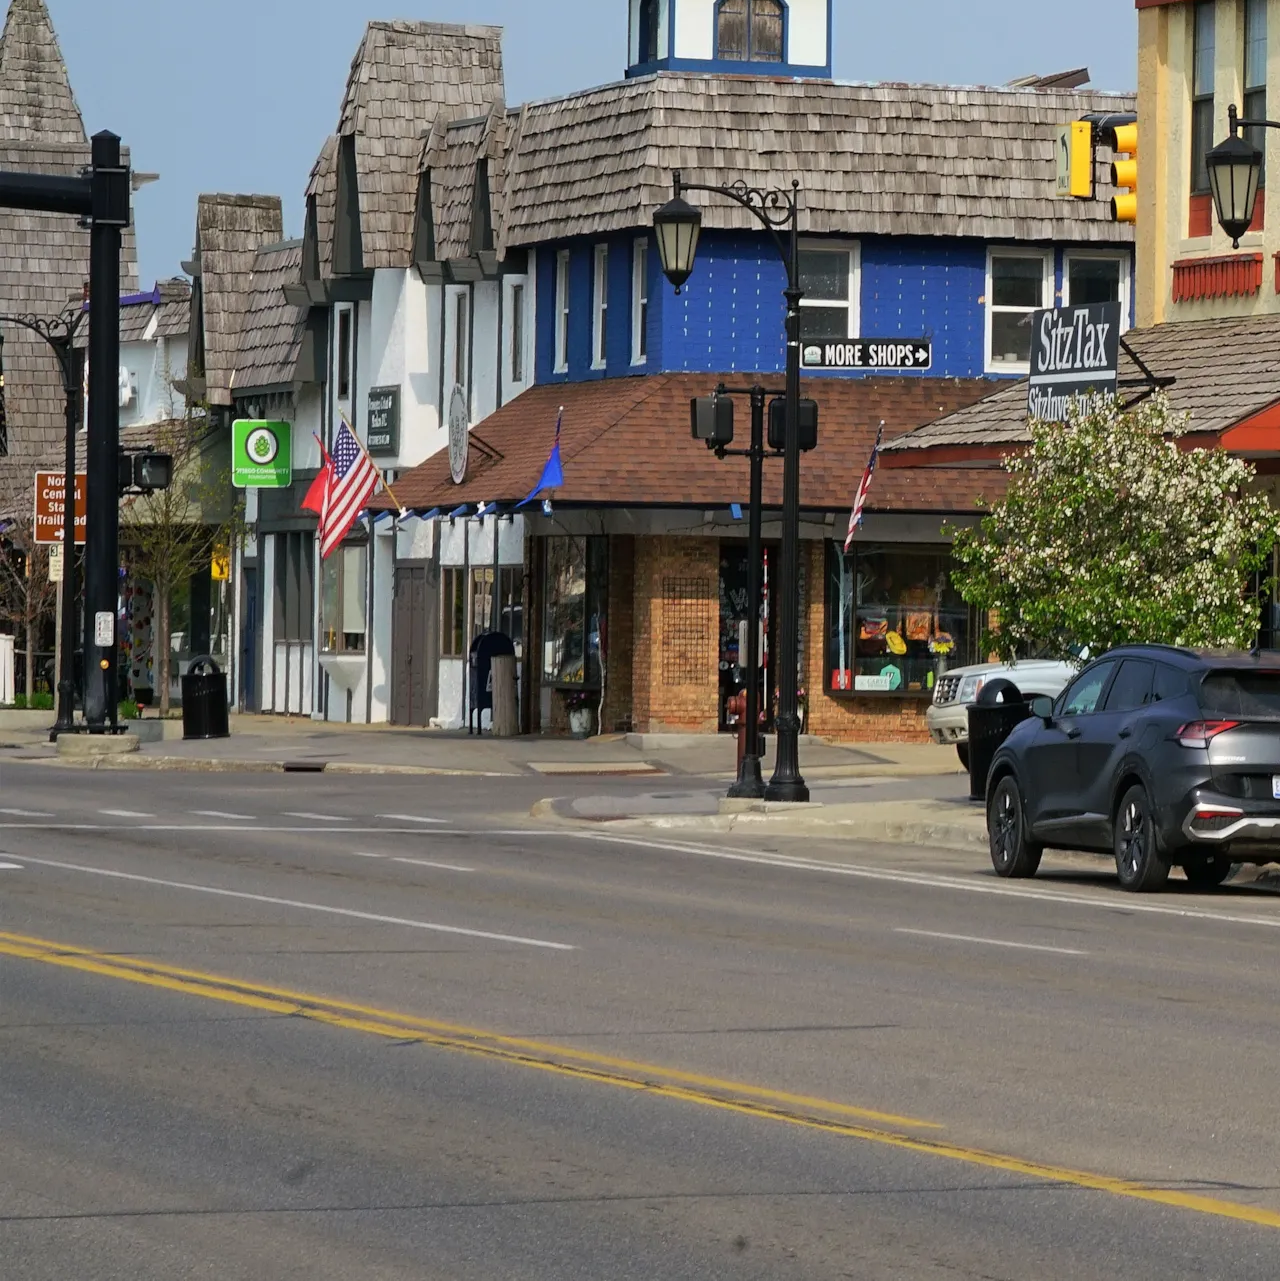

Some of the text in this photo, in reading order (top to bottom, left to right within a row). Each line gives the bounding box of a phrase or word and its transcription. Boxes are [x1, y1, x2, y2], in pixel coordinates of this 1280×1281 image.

[1037, 307, 1110, 373] SitzTax
[825, 344, 914, 366] MORE SHOPS
[47, 475, 77, 487] Nor
[42, 489, 82, 500] Centl
[37, 514, 87, 526] Trailhad
